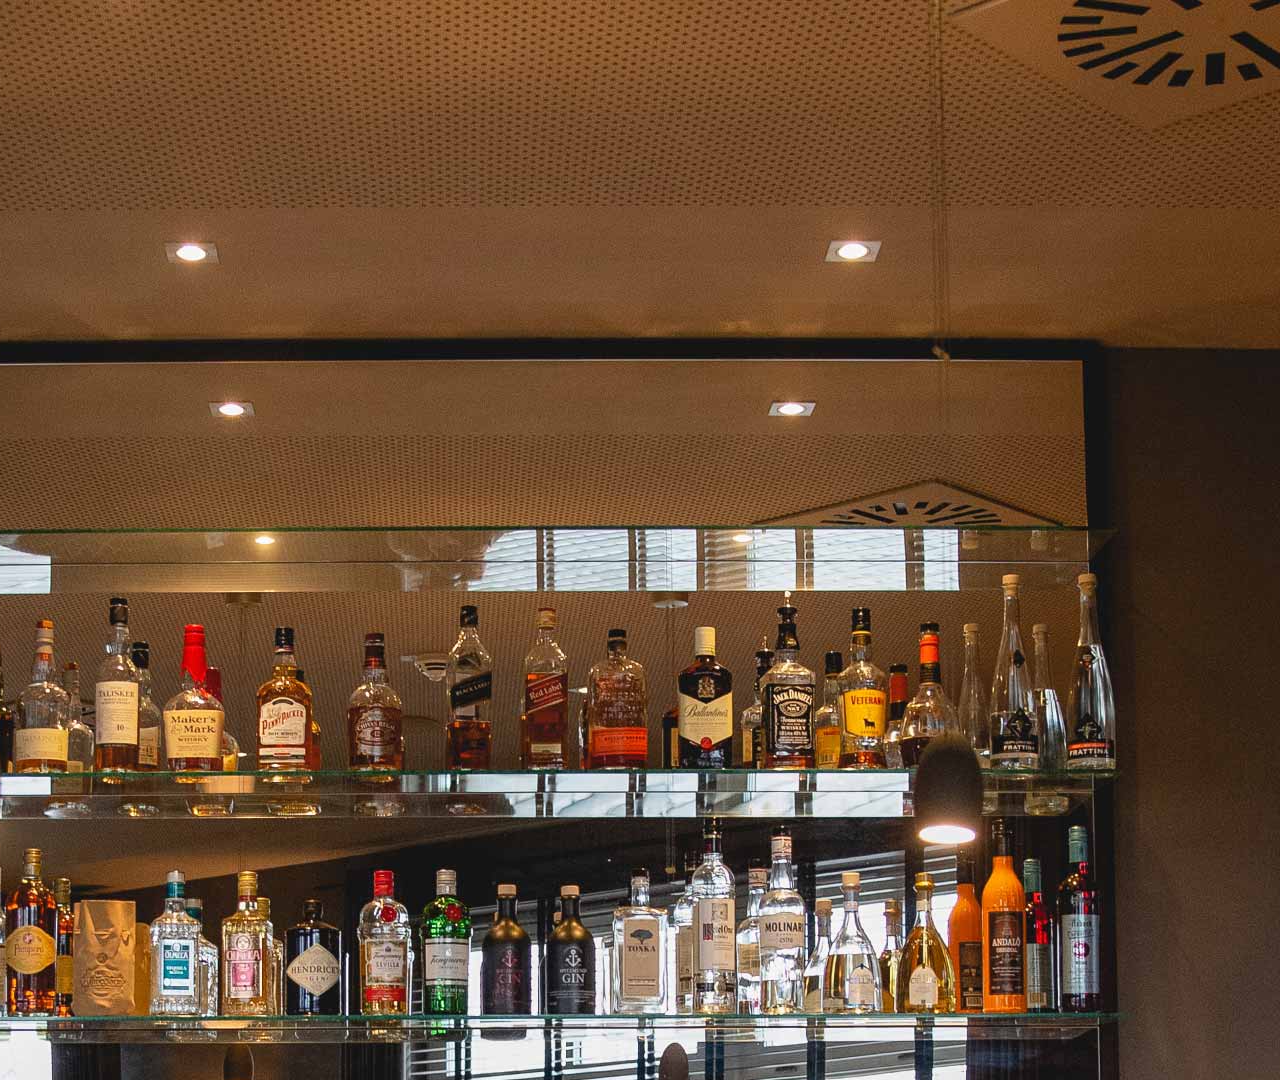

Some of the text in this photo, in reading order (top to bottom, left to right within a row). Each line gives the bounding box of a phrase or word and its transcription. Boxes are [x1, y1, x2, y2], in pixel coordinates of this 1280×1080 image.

[773, 691, 789, 705] JACK
[171, 715, 216, 724] Maker's
[184, 725, 216, 733] Mark
[627, 945, 656, 953] TONKA
[562, 973, 585, 984] GIN
